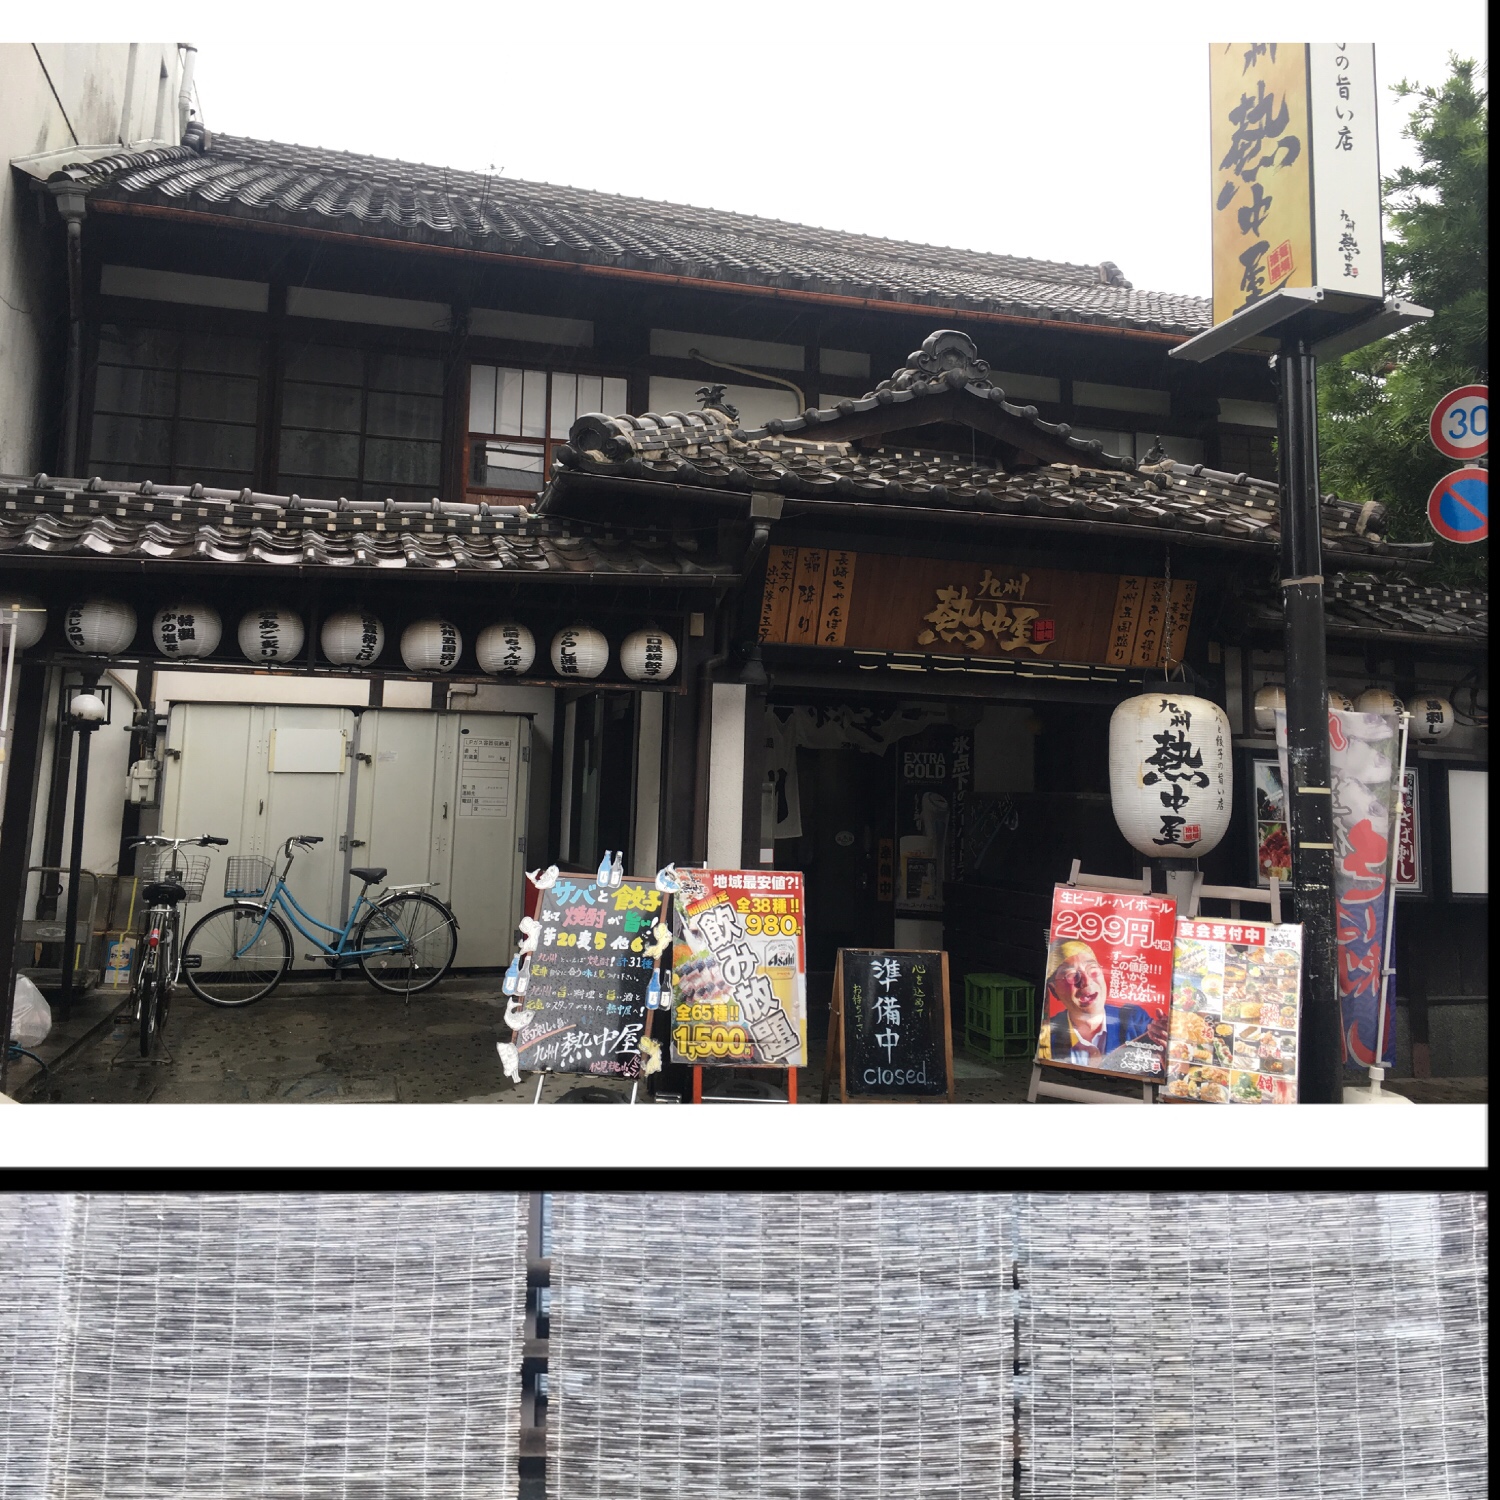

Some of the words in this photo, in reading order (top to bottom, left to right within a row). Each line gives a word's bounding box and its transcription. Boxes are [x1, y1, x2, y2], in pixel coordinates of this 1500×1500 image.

[1334, 43, 1356, 152] の旨い店
[1217, 43, 1302, 318] 州熱中屋
[1448, 404, 1488, 440] 30
[977, 569, 1030, 600] 九州
[903, 752, 946, 765] EXTRA
[903, 764, 946, 779] COLD
[551, 881, 662, 912] サバと餃子
[1055, 910, 1155, 949] 299円
[1179, 922, 1261, 943] 宴会受付中
[768, 952, 795, 967] Asahi
[697, 904, 800, 1062] 飲み放題
[870, 957, 902, 1065] 準備中
